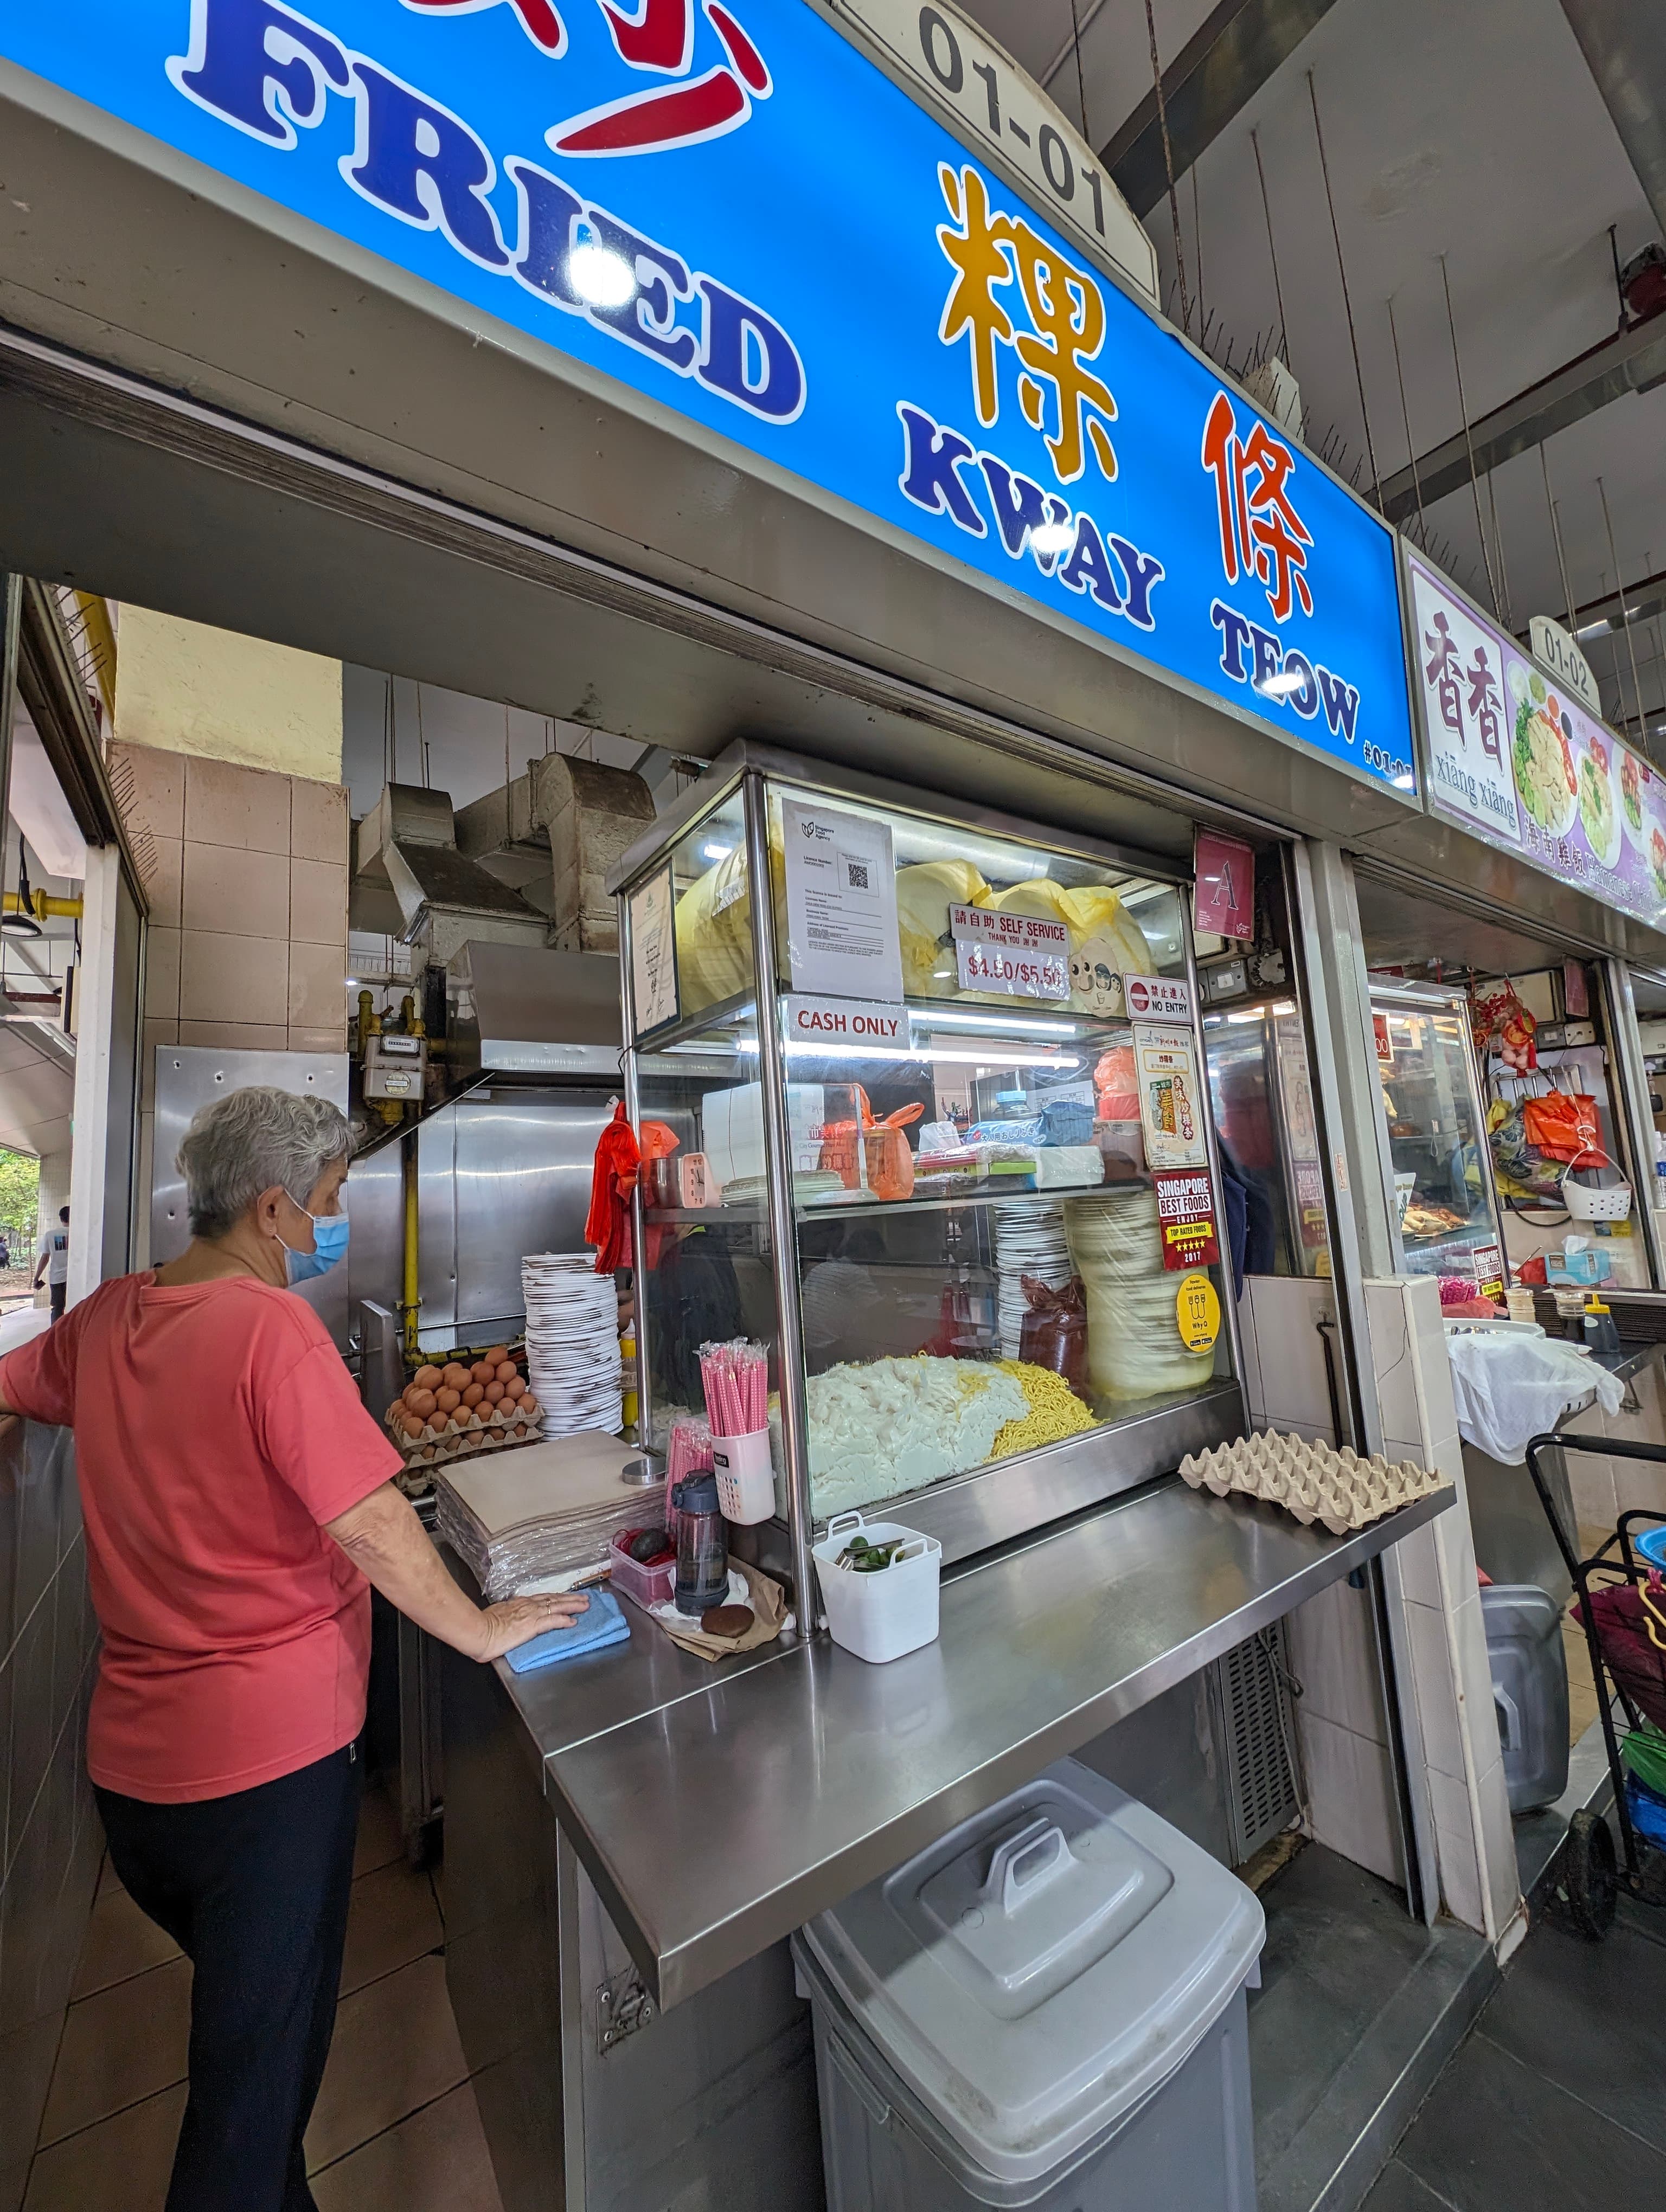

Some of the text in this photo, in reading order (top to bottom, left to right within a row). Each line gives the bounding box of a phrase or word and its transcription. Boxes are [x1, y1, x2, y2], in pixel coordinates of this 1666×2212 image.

[919, 5, 1106, 237] 01-01
[168, 0, 806, 424] FRIED
[898, 402, 1359, 743] KWAY TEOW
[1545, 627, 1589, 697] 01-02
[1424, 610, 1504, 774] 香香
[1210, 860, 1239, 910] A
[954, 909, 1066, 941] 請自助 SELF SERVICE
[988, 932, 1007, 943] THANK
[1008, 935, 1020, 944] YOU
[1150, 985, 1187, 1000] 禁止進入
[1152, 1000, 1187, 1014] NO ENTRY
[797, 1009, 898, 1037] CASH ONLY
[1157, 1177, 1209, 1198] SINGAPORE
[1159, 1195, 1209, 1214] BEST FOODS
[1170, 1224, 1207, 1237] TOP RATED FOODS
[1176, 1214, 1198, 1224] ENJOY
[1184, 1251, 1201, 1263] 2017
